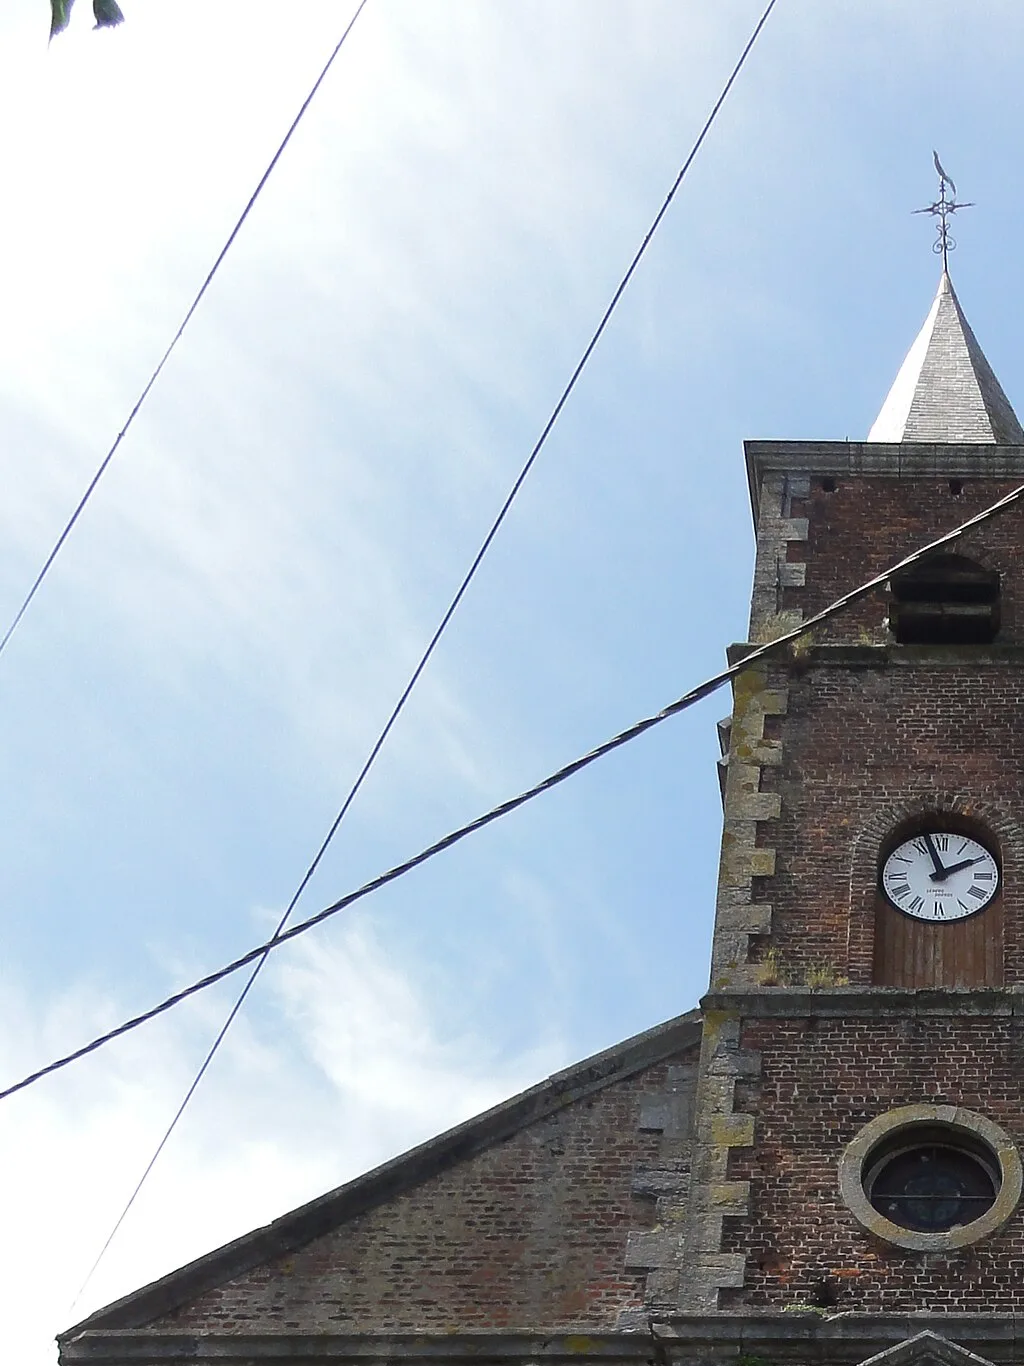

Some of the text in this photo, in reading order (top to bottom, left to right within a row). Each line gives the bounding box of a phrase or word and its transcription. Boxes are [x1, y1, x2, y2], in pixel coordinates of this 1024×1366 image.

[935, 837, 949, 852] XII
[957, 842, 968, 855] I
[895, 855, 913, 867] X
[891, 884, 912, 901] VIII
[908, 896, 925, 912] VII
[957, 898, 968, 910] V
